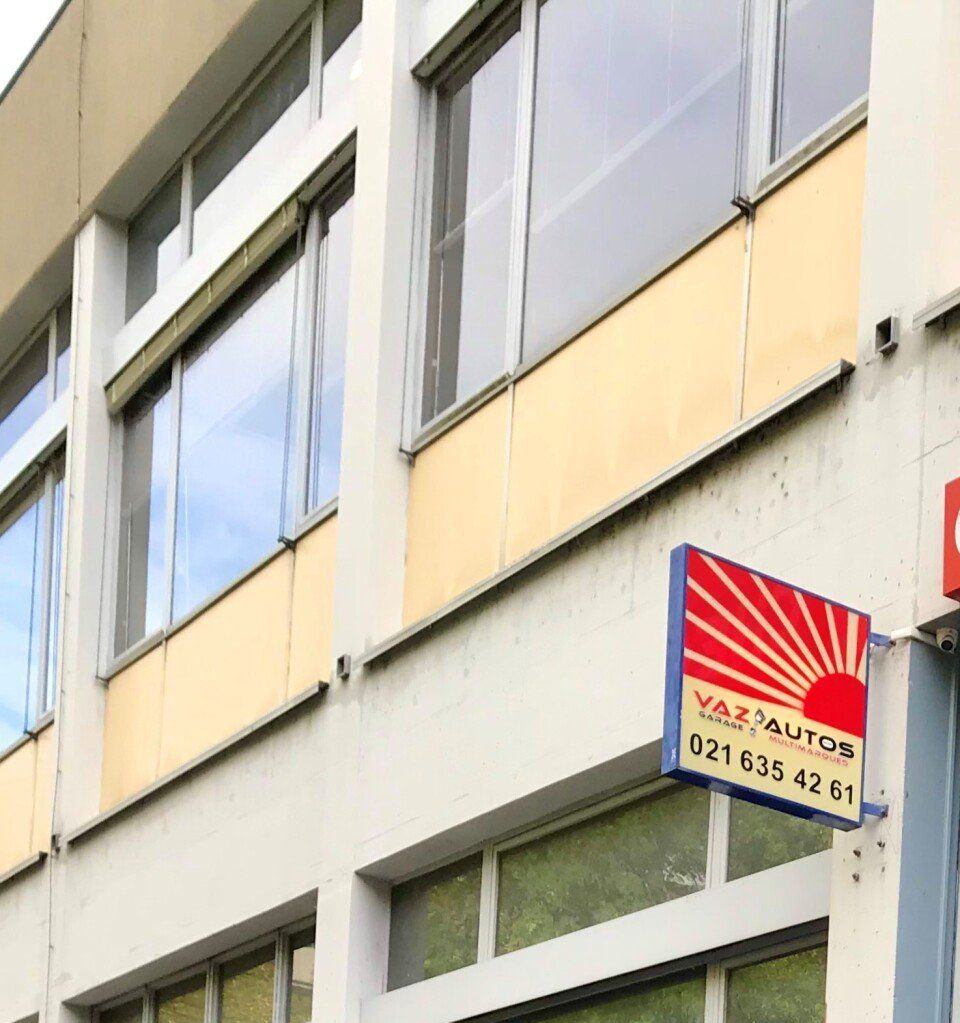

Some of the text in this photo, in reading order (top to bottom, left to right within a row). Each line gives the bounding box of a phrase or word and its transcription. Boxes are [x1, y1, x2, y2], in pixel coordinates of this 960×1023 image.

[694, 690, 855, 759] VAZ AUTOS
[698, 711, 849, 767] GARAGE MULTIMARQUES
[690, 733, 853, 805] 021 635 42 61
